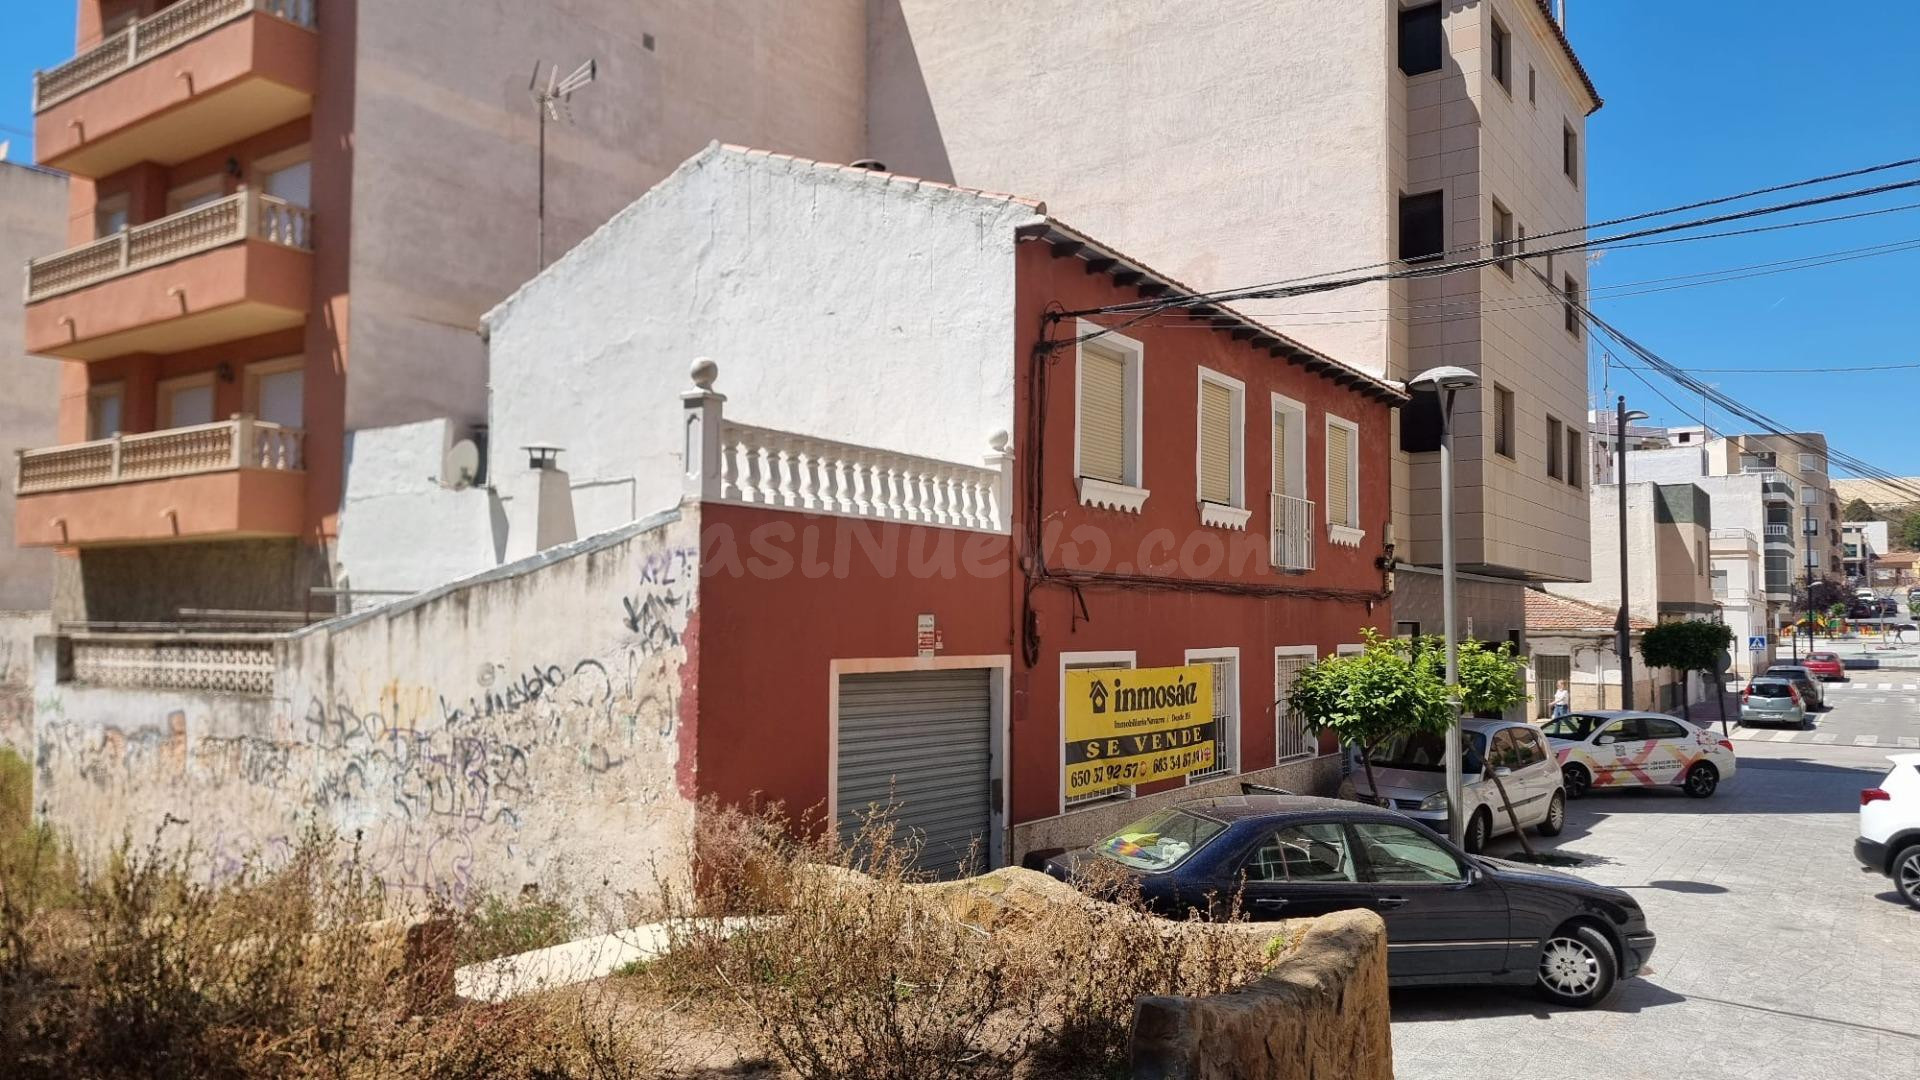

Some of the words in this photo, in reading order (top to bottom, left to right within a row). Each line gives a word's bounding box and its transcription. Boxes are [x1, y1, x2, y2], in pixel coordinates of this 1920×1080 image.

[1086, 739, 1121, 760] SE
[1134, 727, 1202, 752] VENDE
[1071, 769, 1091, 789] 650
[1092, 766, 1104, 783] 37
[1106, 764, 1121, 780] 92
[1122, 761, 1139, 779] 57
[1153, 756, 1168, 774] 683
[1170, 754, 1181, 770] 34
